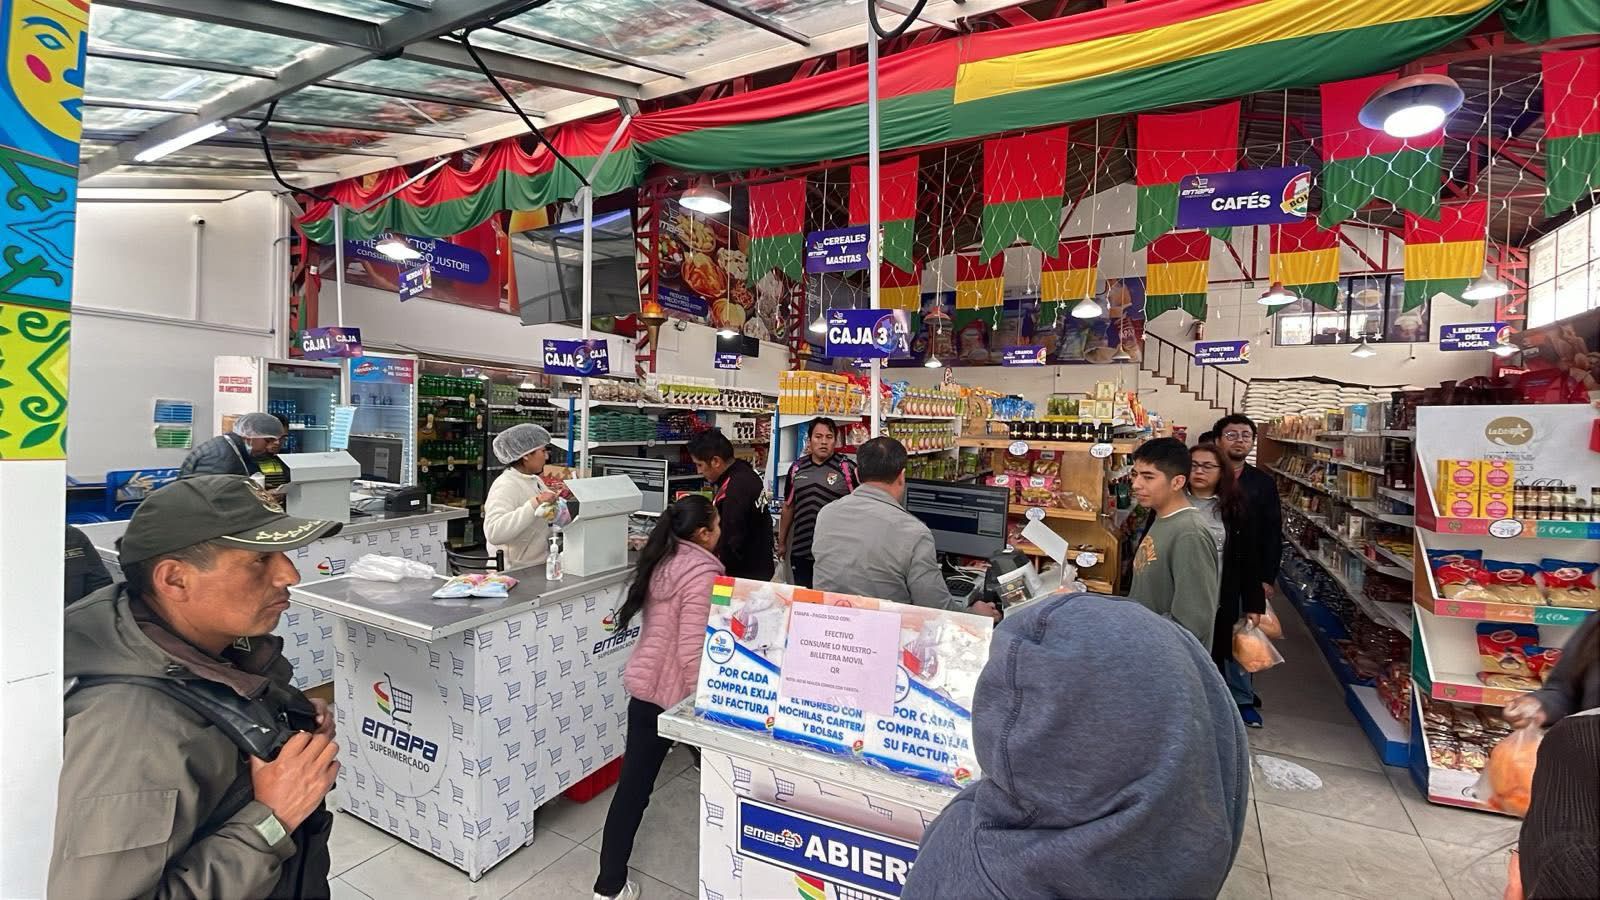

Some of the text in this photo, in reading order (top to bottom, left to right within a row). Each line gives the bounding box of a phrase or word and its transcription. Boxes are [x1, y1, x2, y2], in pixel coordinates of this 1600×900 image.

[1211, 191, 1271, 211] CAFÉS
[823, 234, 866, 246] CEREALES
[840, 246, 848, 254] Y
[826, 254, 862, 265] MASITAS
[829, 327, 888, 345] CAJA 3
[1452, 326, 1496, 334] LIMPIEZA
[303, 337, 330, 352] CAJA 1
[336, 335, 357, 343] CAJA
[1458, 340, 1490, 348] HOGAR
[545, 352, 584, 368] CAJA 2
[590, 348, 607, 359] CAJA
[596, 360, 602, 368] 2
[592, 626, 640, 654] emapa
[824, 630, 854, 640] EFECTIVO
[800, 639, 831, 650] CONSUME
[842, 644, 872, 654] NUESTRO
[810, 651, 864, 666] BILLETERA MOVIL
[719, 666, 768, 684] POR CADA
[830, 666, 840, 674] QR
[707, 678, 778, 701] COMPRA EXIJA
[711, 694, 769, 715] SU FACTURA
[802, 700, 840, 713] INGRESO
[841, 706, 862, 718] CON
[778, 704, 824, 724] MOCHILAS,
[893, 706, 917, 721] POR
[802, 723, 844, 740] Y BOLSAS
[877, 720, 930, 742] COMPRA
[362, 716, 439, 763] emapa
[884, 738, 898, 750] SU
[369, 740, 430, 773] SUPERMERCADO
[744, 824, 796, 848] emapa
[804, 834, 914, 886] ABIER
